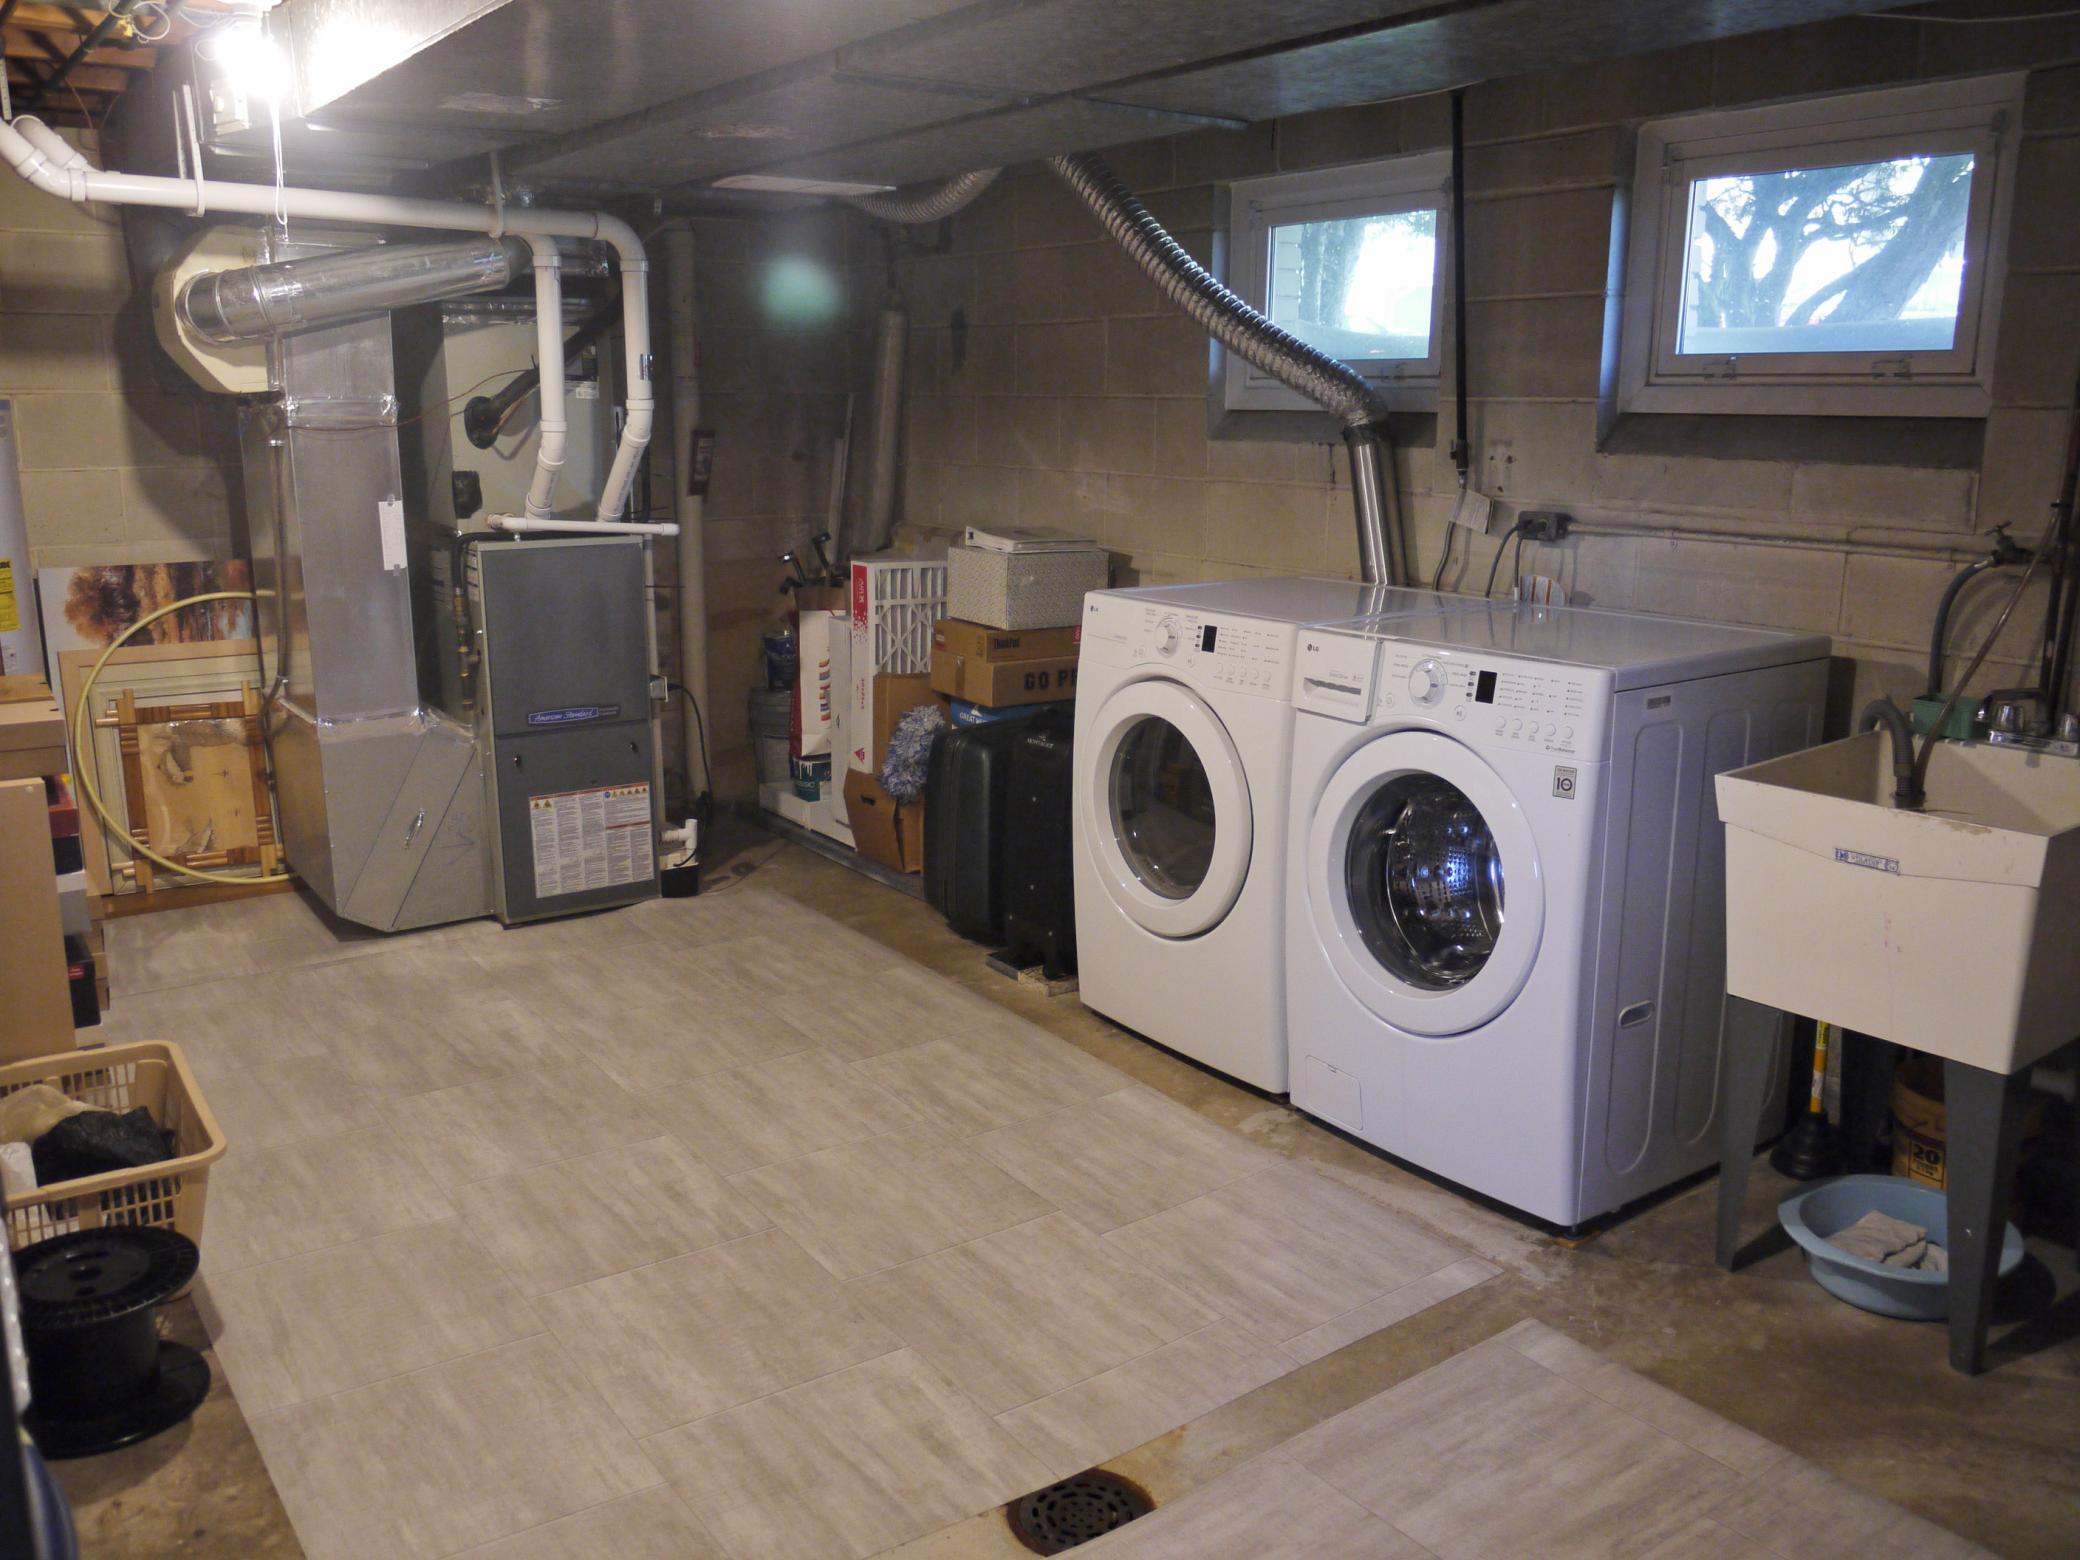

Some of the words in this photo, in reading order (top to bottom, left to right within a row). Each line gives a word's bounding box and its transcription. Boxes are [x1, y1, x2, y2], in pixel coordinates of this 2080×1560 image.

[1025, 672, 1050, 691] GO
[1557, 777, 1573, 791] 10
[1913, 1143, 1940, 1165] 20
